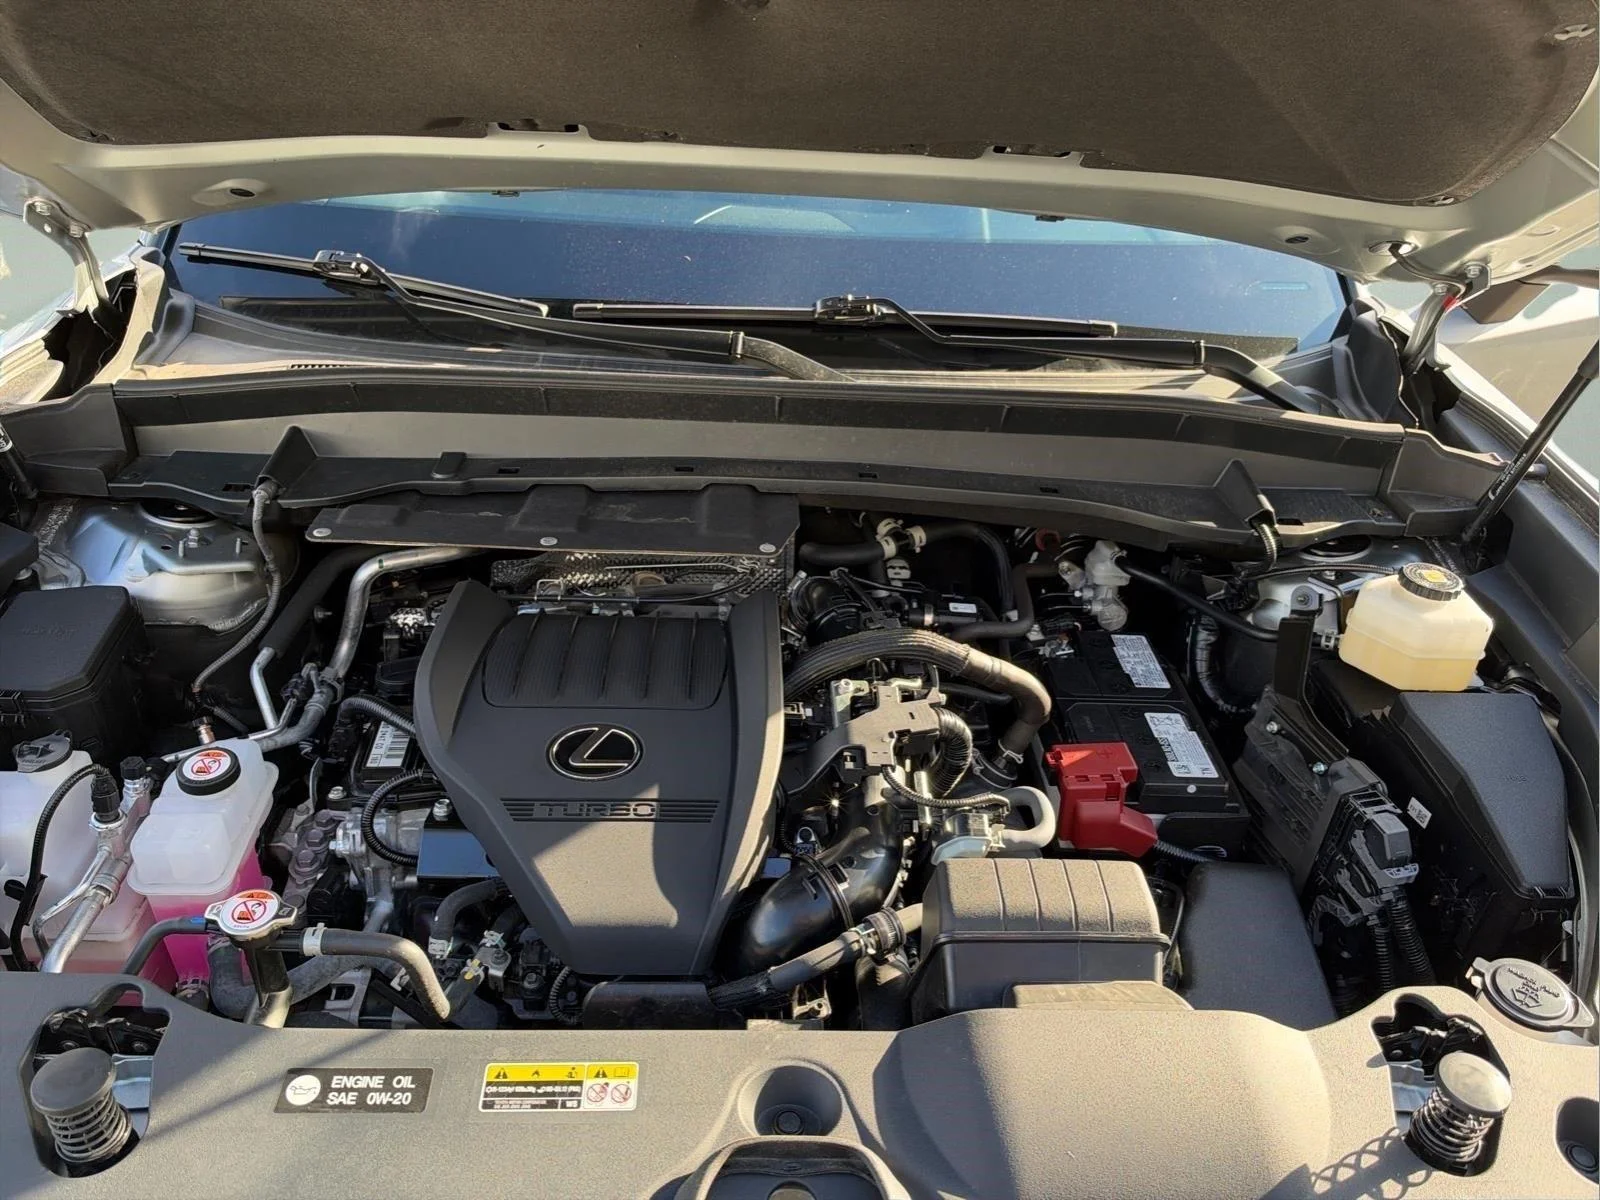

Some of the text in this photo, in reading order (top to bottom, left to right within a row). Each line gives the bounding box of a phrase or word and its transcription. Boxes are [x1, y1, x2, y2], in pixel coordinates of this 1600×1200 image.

[539, 804, 656, 817] TURBO
[331, 1075, 416, 1089] ENGINE OIL
[326, 1092, 412, 1105] SAE 0W-20
